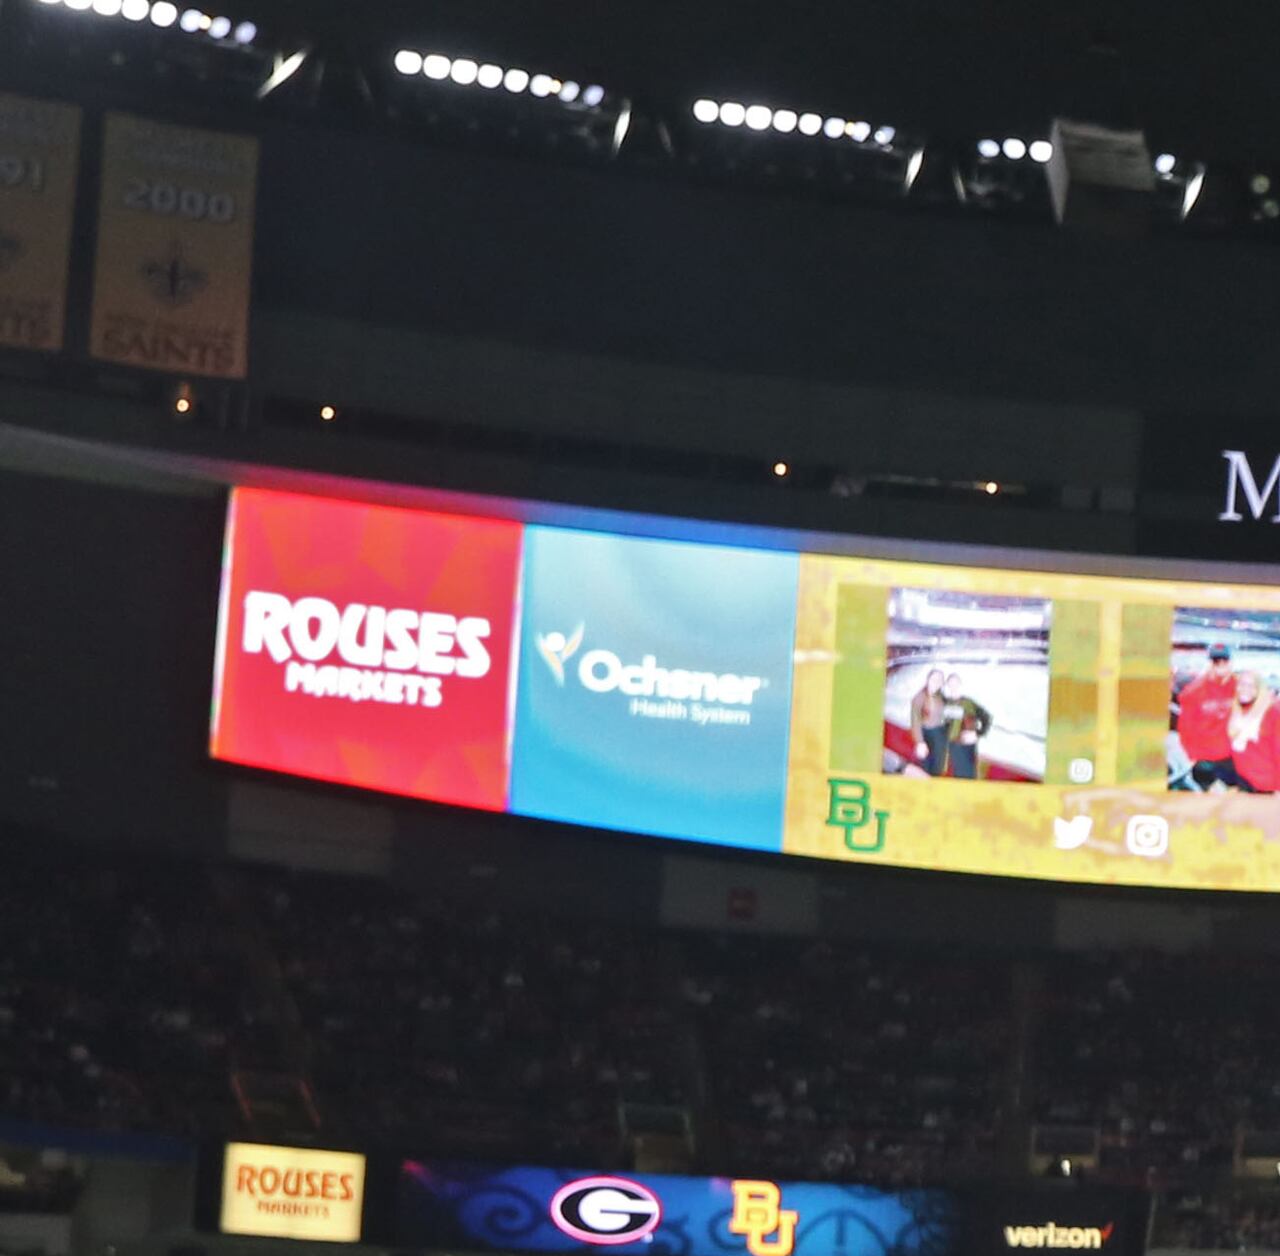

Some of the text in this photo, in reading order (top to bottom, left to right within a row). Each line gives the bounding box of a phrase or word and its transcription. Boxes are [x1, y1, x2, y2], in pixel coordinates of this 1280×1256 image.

[243, 590, 491, 678] ROUSES
[285, 661, 443, 708] MARKETS
[578, 649, 762, 704] Ochsner
[236, 1163, 354, 1201] ROUSES
[1003, 1221, 1102, 1249] verizon
